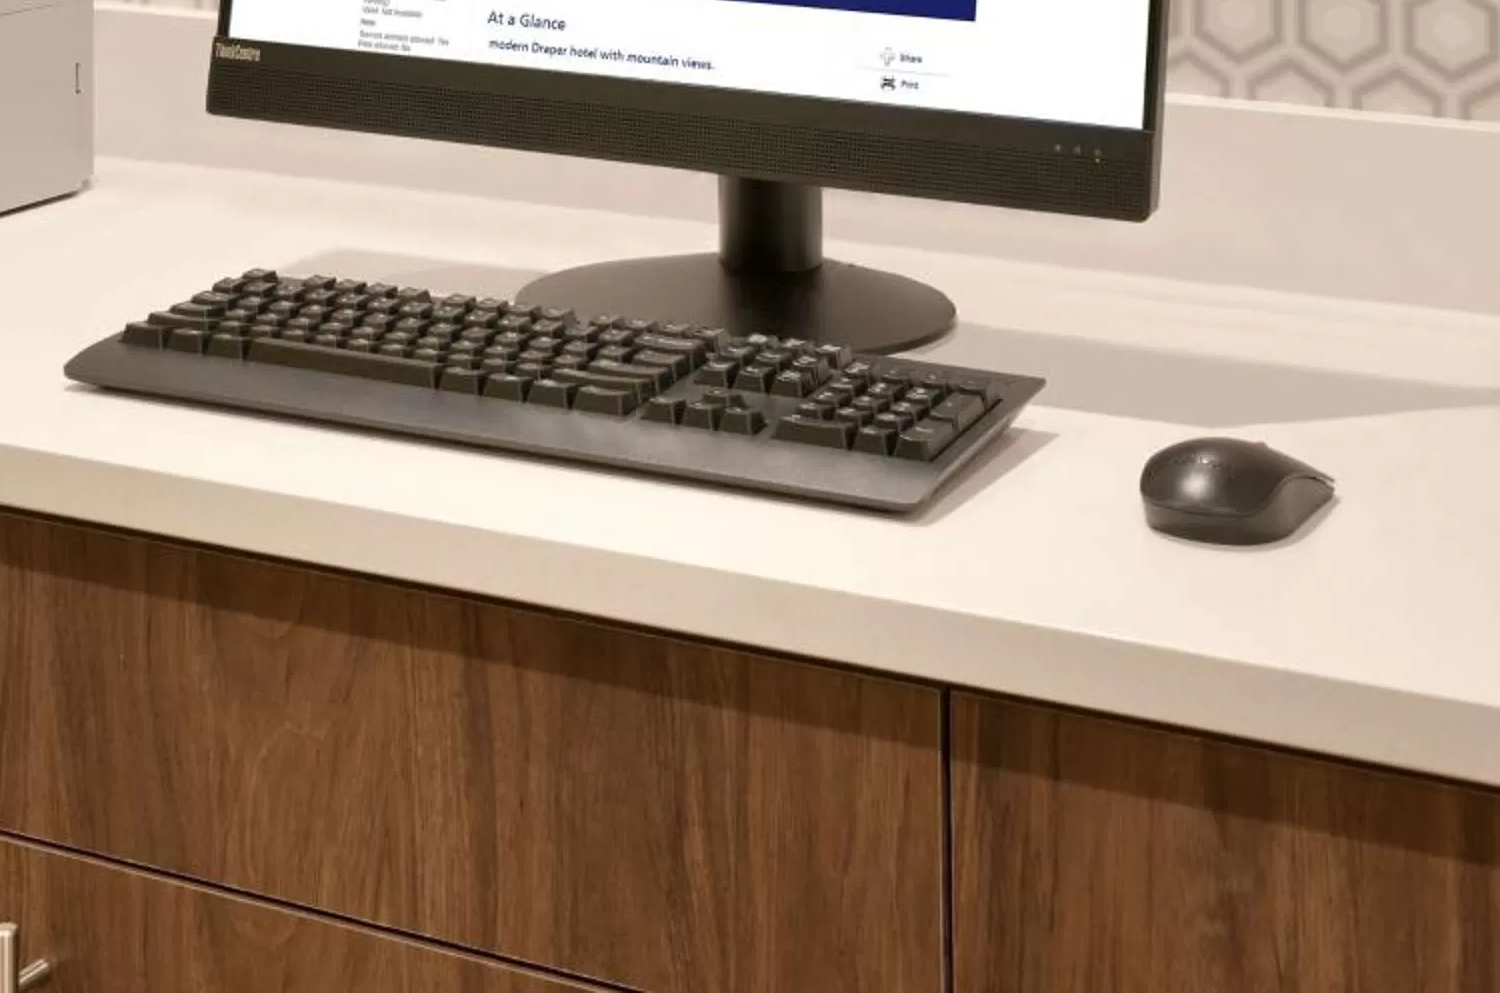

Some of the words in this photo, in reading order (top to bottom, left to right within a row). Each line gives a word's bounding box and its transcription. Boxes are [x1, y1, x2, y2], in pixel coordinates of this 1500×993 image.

[487, 10, 504, 25] At
[507, 15, 515, 26] a
[519, 13, 566, 31] Glance
[488, 39, 529, 53] modern
[531, 42, 567, 57] Draper
[569, 45, 598, 60] hotel
[600, 48, 625, 62] with
[626, 51, 679, 68] mountain
[681, 57, 715, 71] views.
